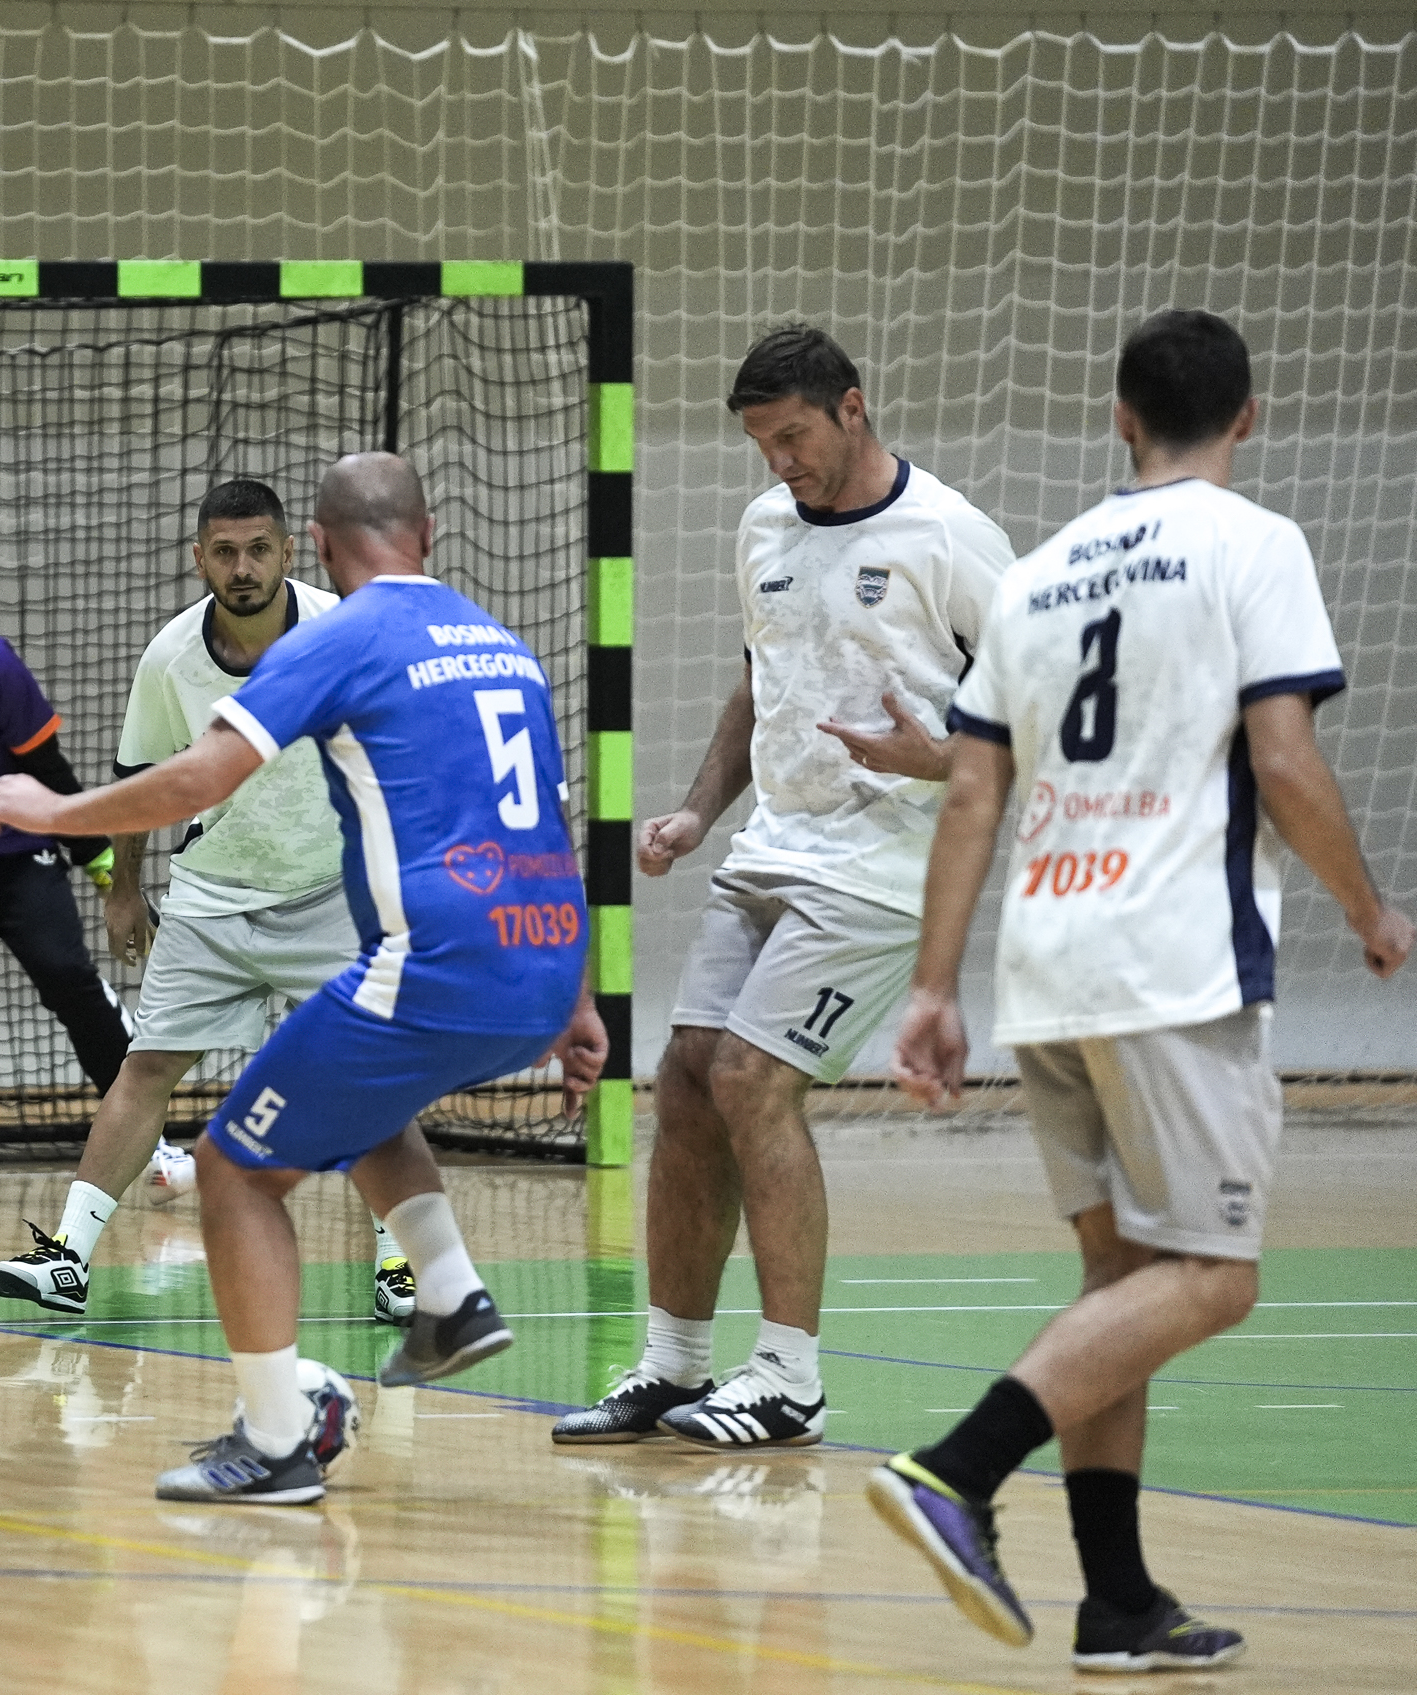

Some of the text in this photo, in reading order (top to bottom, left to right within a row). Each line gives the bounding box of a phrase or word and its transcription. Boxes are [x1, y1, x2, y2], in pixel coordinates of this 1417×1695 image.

[426, 624, 506, 647] BOSNA
[473, 689, 540, 831] 5
[488, 903, 579, 947] 17039
[803, 987, 855, 1039] 17
[243, 1086, 288, 1137] 5
